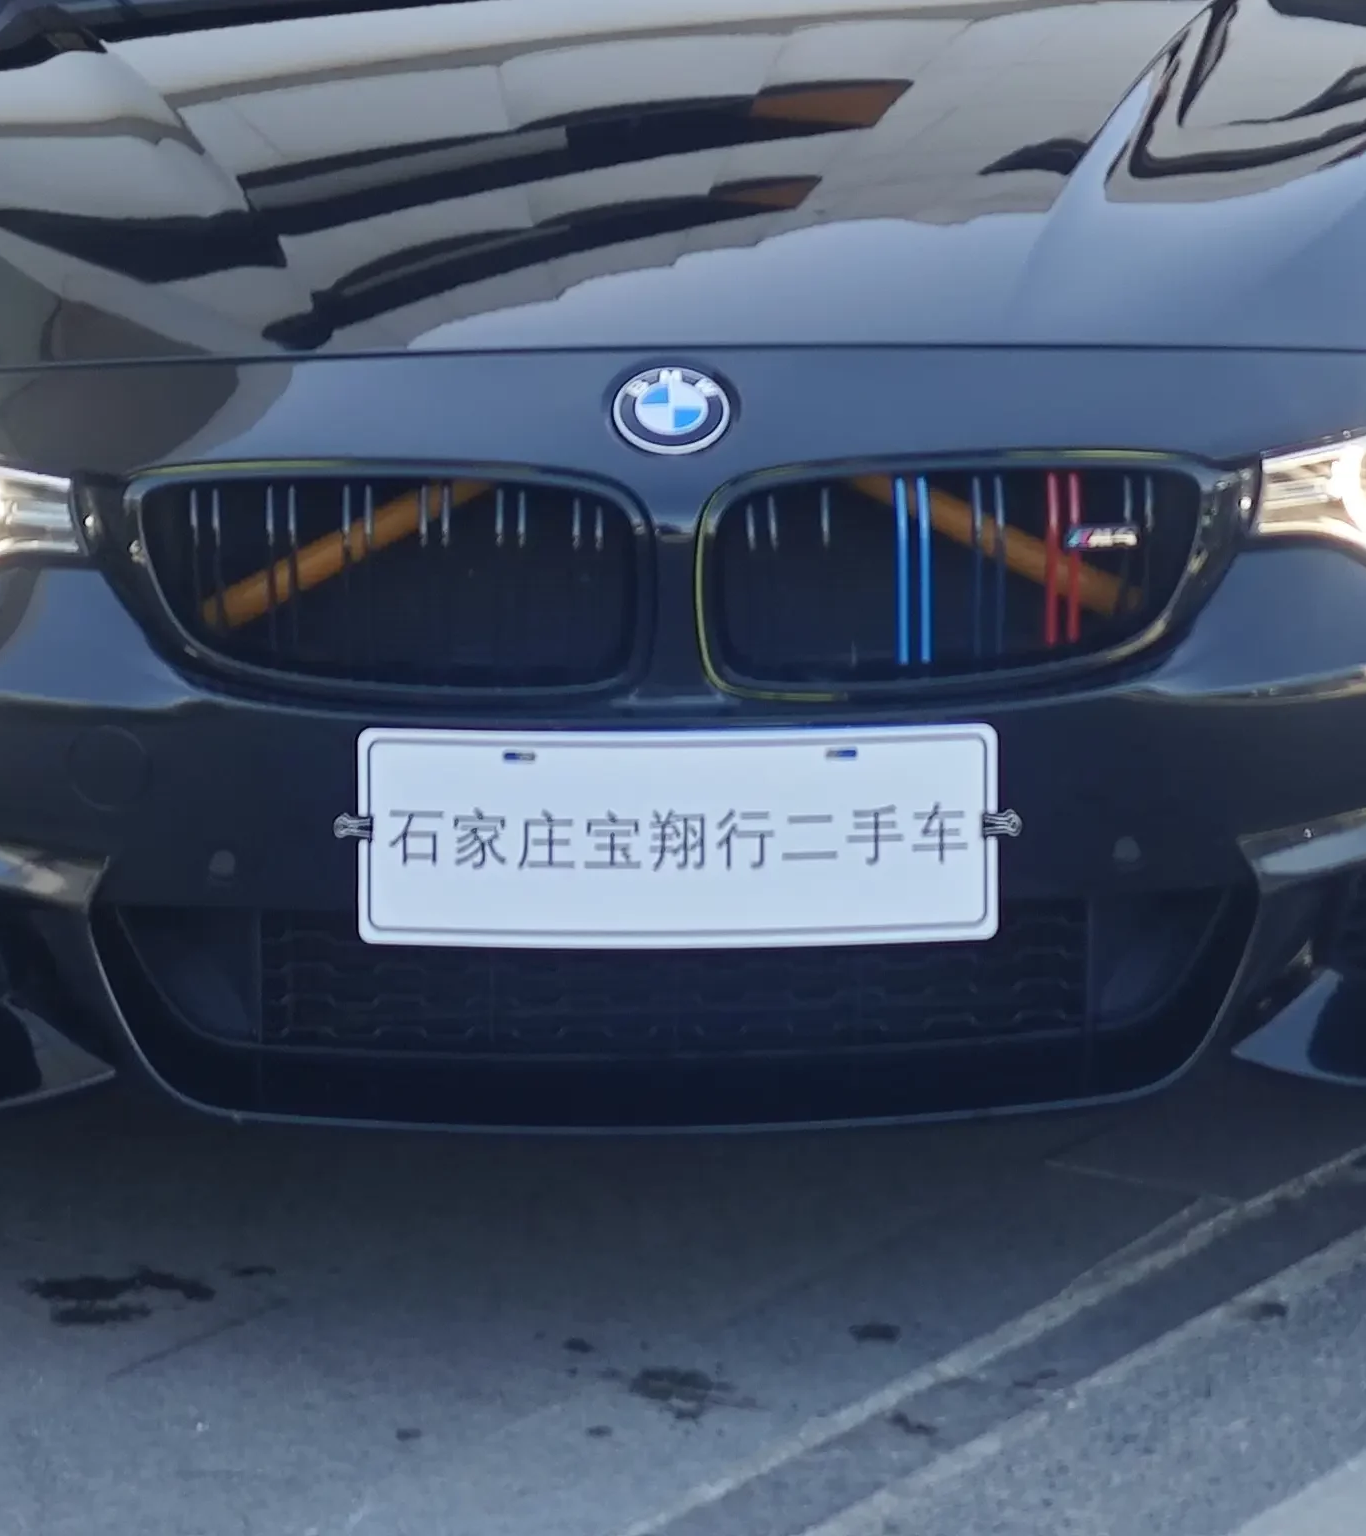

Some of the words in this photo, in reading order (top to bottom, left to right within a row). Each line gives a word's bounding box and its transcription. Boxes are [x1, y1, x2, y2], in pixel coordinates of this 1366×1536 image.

[388, 800, 969, 870] 石家庄宝翔行二手车
